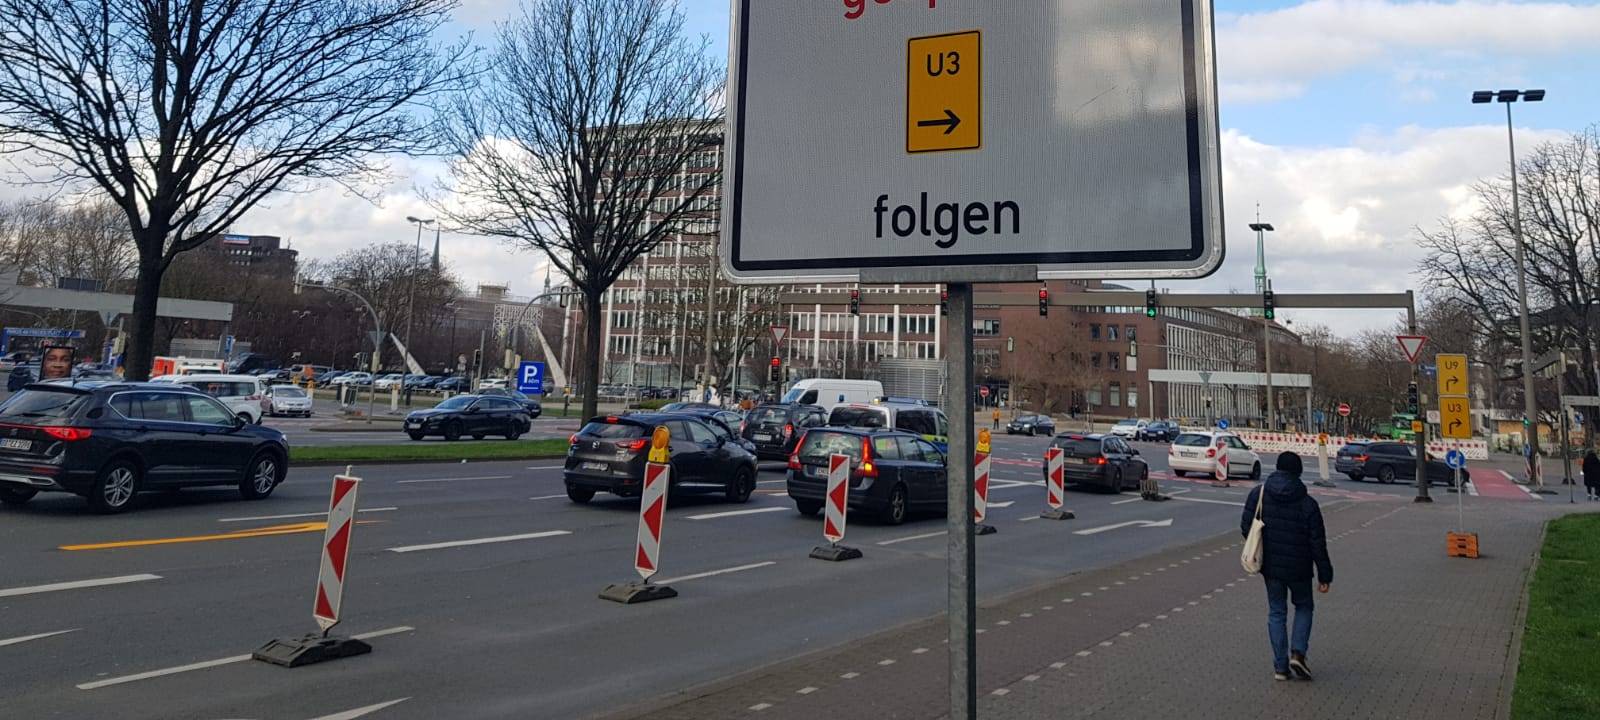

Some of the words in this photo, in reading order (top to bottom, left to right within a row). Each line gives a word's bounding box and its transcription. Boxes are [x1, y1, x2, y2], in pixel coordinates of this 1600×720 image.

[926, 51, 961, 77] U3
[873, 191, 1020, 249] folgen
[523, 365, 538, 384] P
[1445, 361, 1459, 370] U9
[1447, 403, 1462, 413] U3
